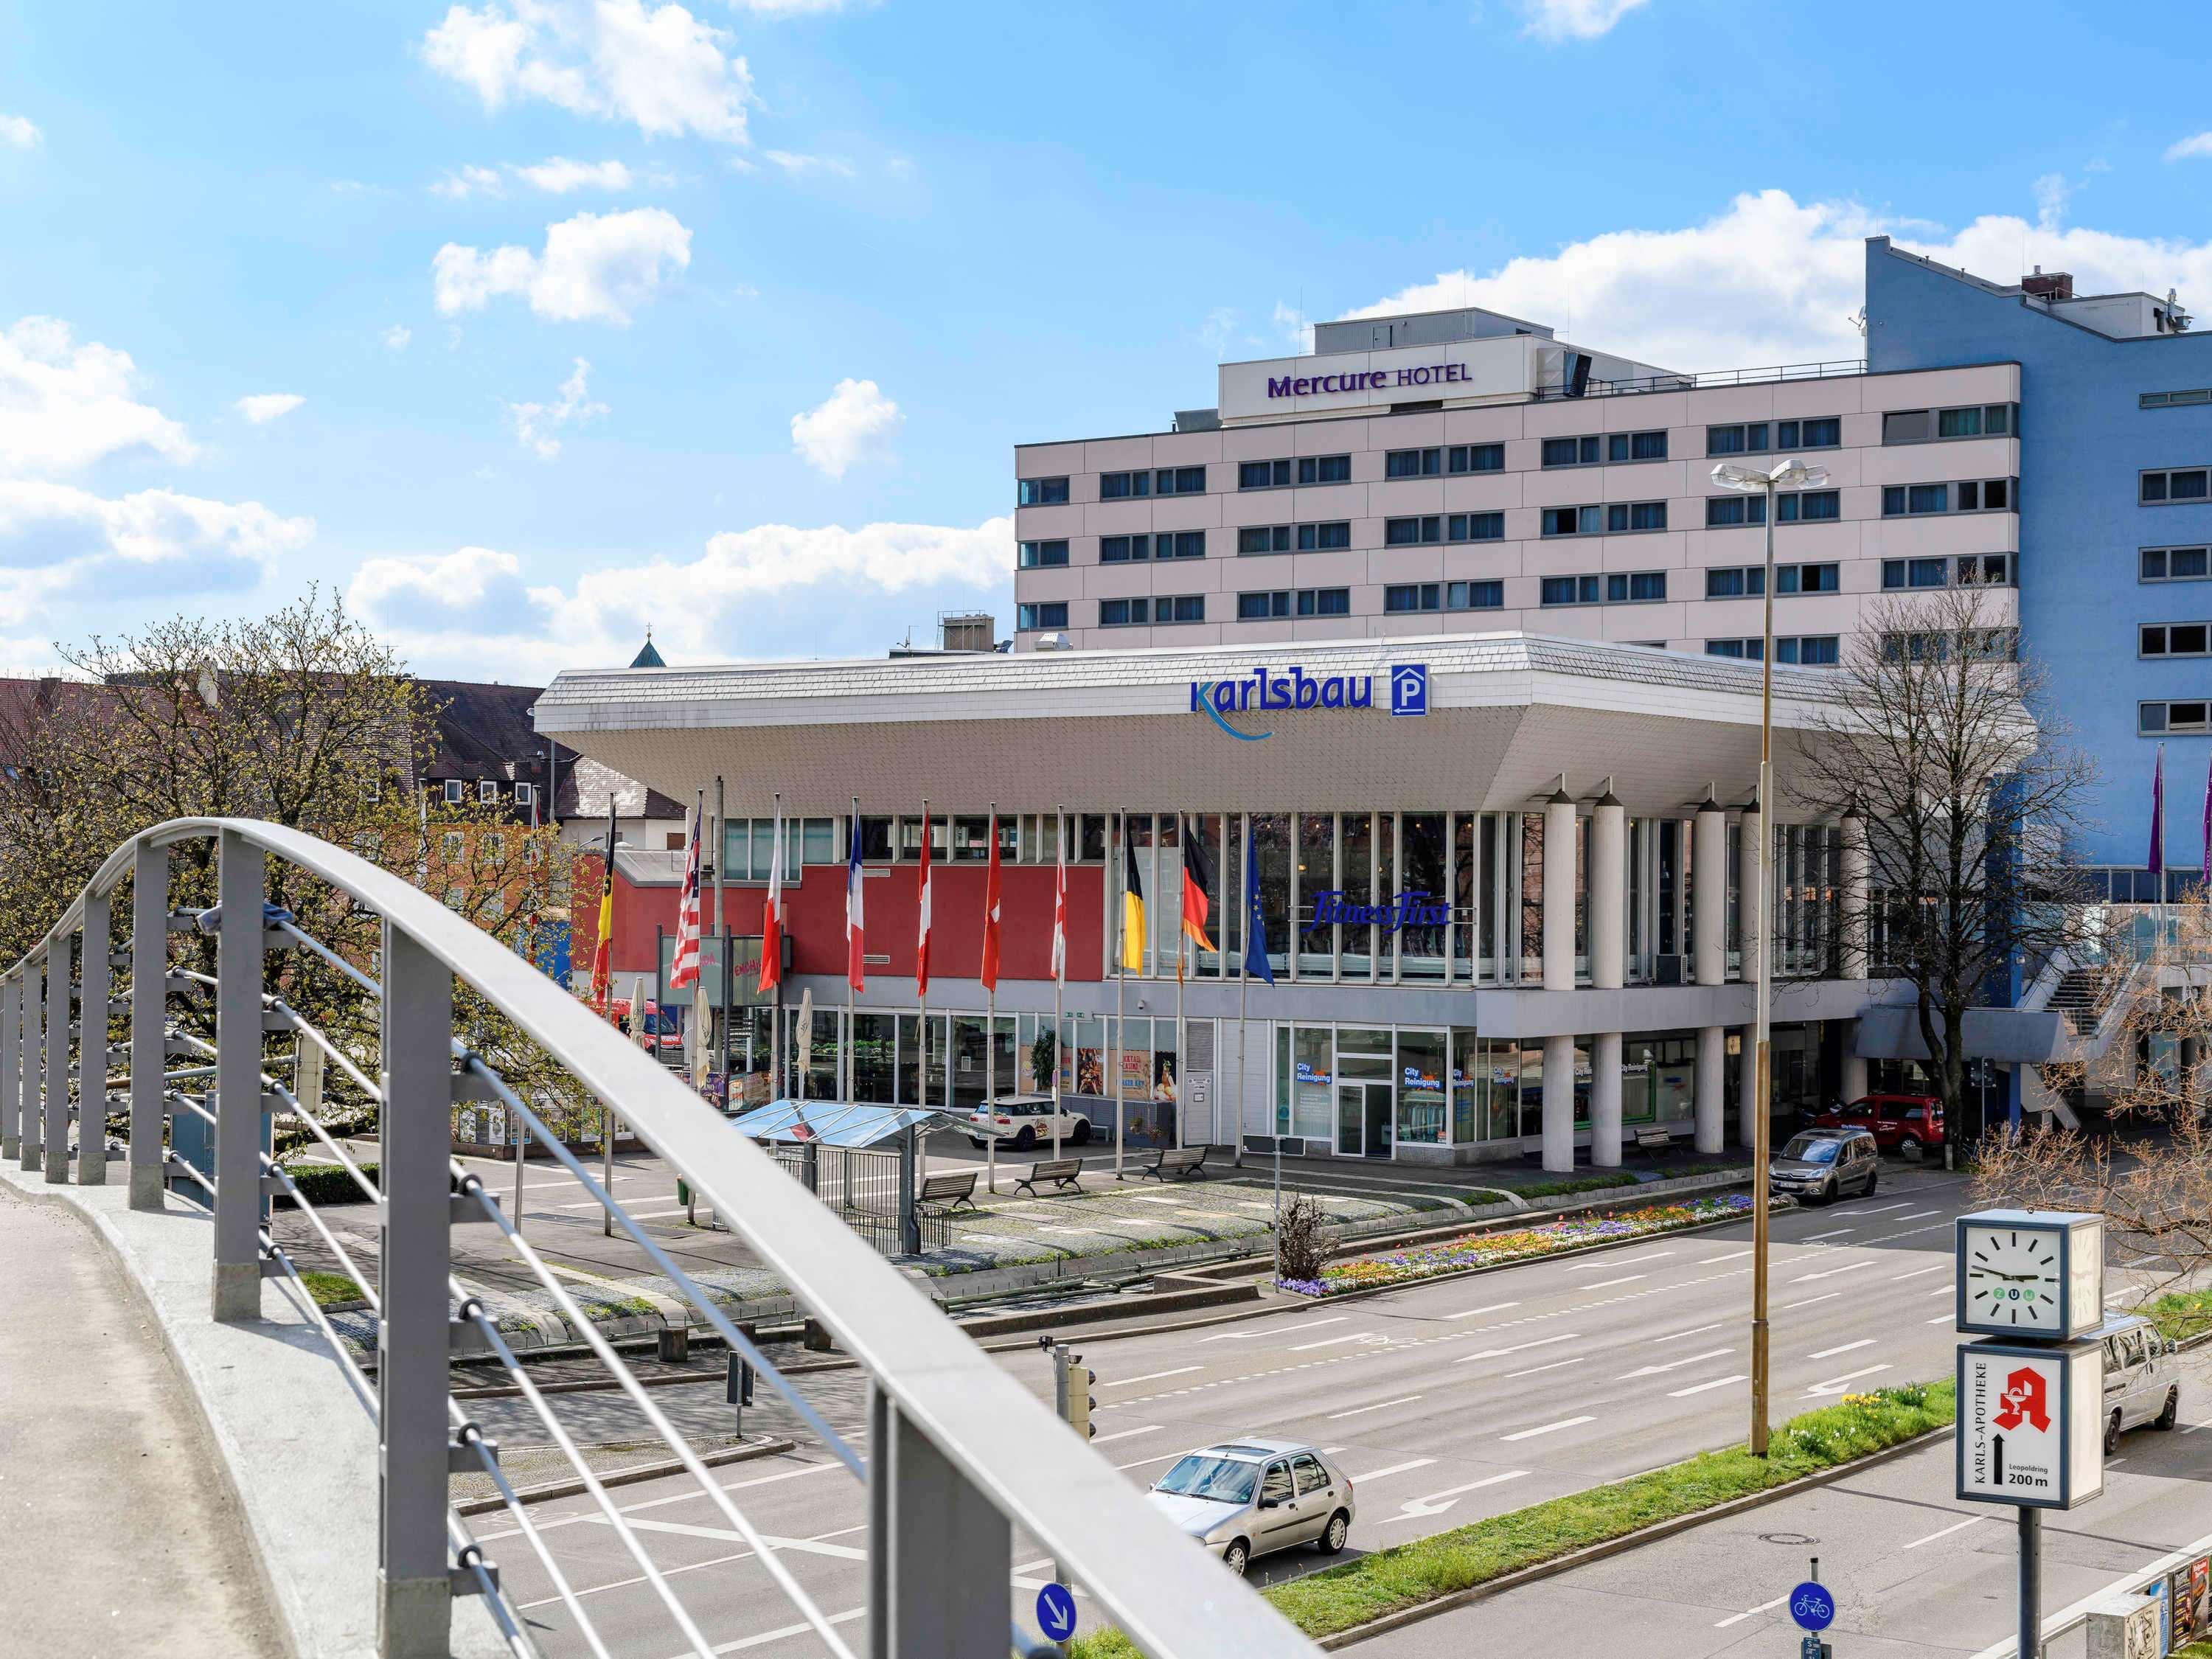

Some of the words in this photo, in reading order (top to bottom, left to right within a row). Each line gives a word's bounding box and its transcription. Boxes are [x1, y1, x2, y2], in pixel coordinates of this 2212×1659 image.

[1267, 371, 1387, 398] Mercure
[1397, 363, 1472, 387] HOTEL
[1401, 678, 1421, 706] P
[1297, 1062, 1310, 1072] City
[1405, 1067, 1419, 1077] City
[1297, 1073, 1331, 1082] Reinigung
[1405, 1077, 1440, 1088] Reinigung
[1975, 1362, 1986, 1484] KARLS-APOTHEKE
[2008, 1463, 2048, 1474] Leopoldring
[2008, 1473, 2033, 1486] 200
[2035, 1477, 2048, 1487] m
